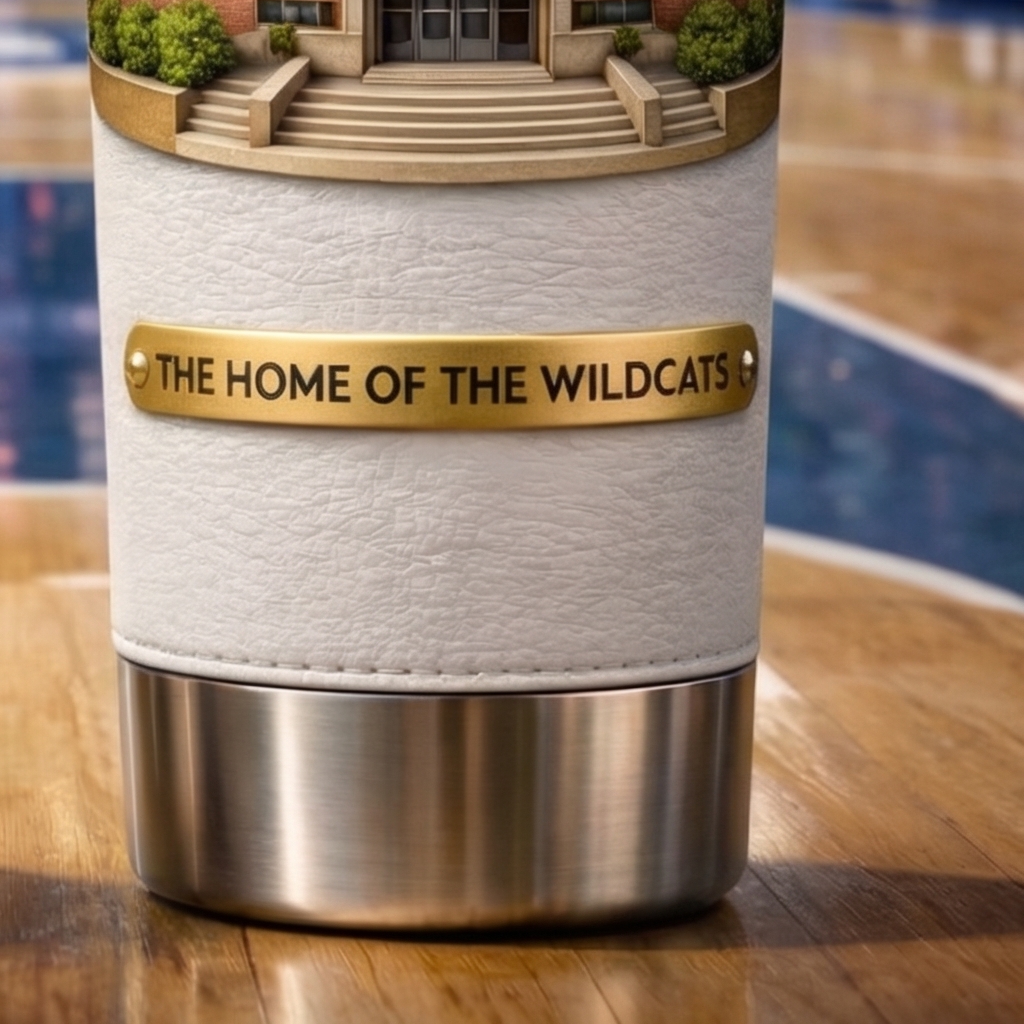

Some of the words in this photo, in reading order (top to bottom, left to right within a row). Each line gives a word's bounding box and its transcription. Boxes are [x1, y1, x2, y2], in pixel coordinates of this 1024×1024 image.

[155, 353, 215, 395] THE
[226, 360, 351, 403] HOME
[365, 365, 427, 405] OF
[440, 365, 528, 404] THE
[540, 352, 729, 403] WILDCATS
